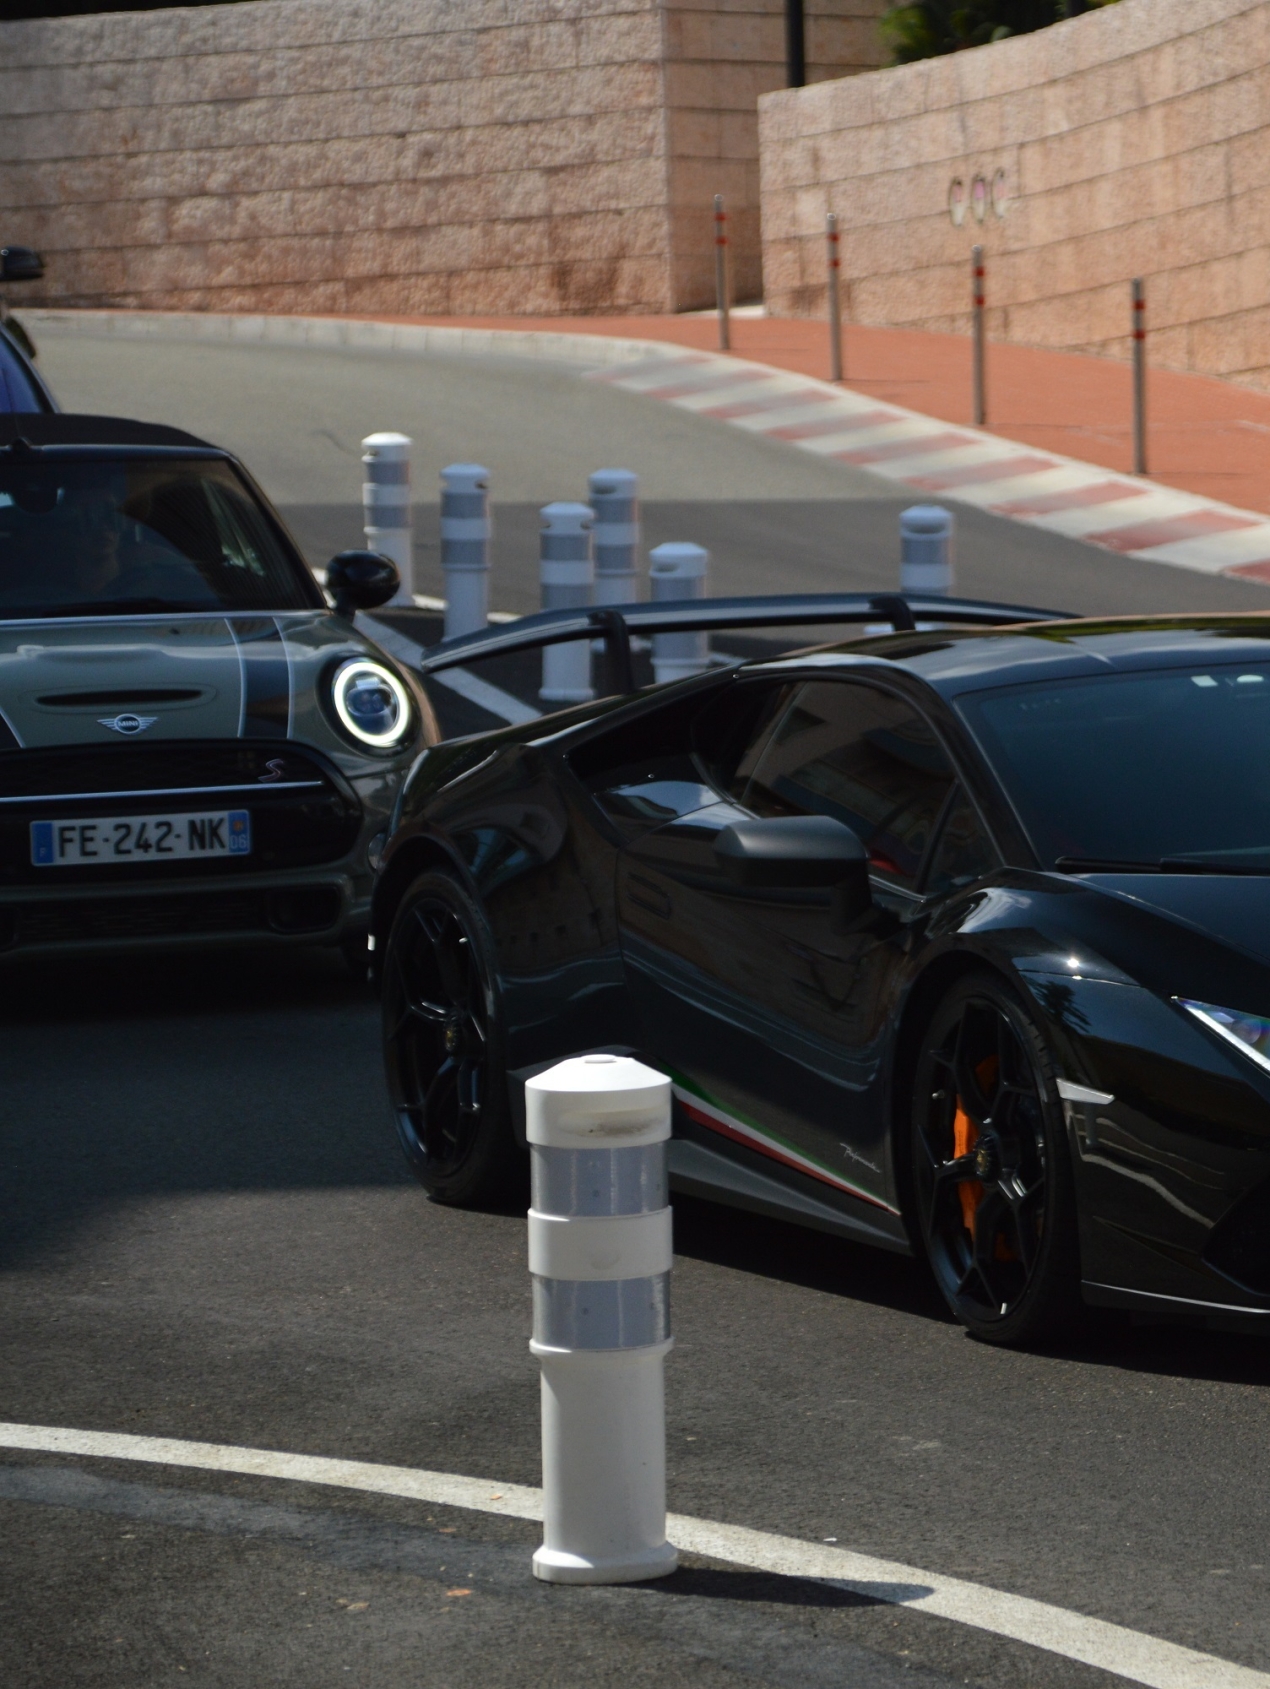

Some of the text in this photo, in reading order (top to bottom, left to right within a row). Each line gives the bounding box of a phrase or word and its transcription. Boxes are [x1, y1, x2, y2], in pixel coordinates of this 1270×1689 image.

[258, 758, 284, 783] S
[58, 817, 226, 858] FE-242-NK
[229, 834, 247, 849] 06
